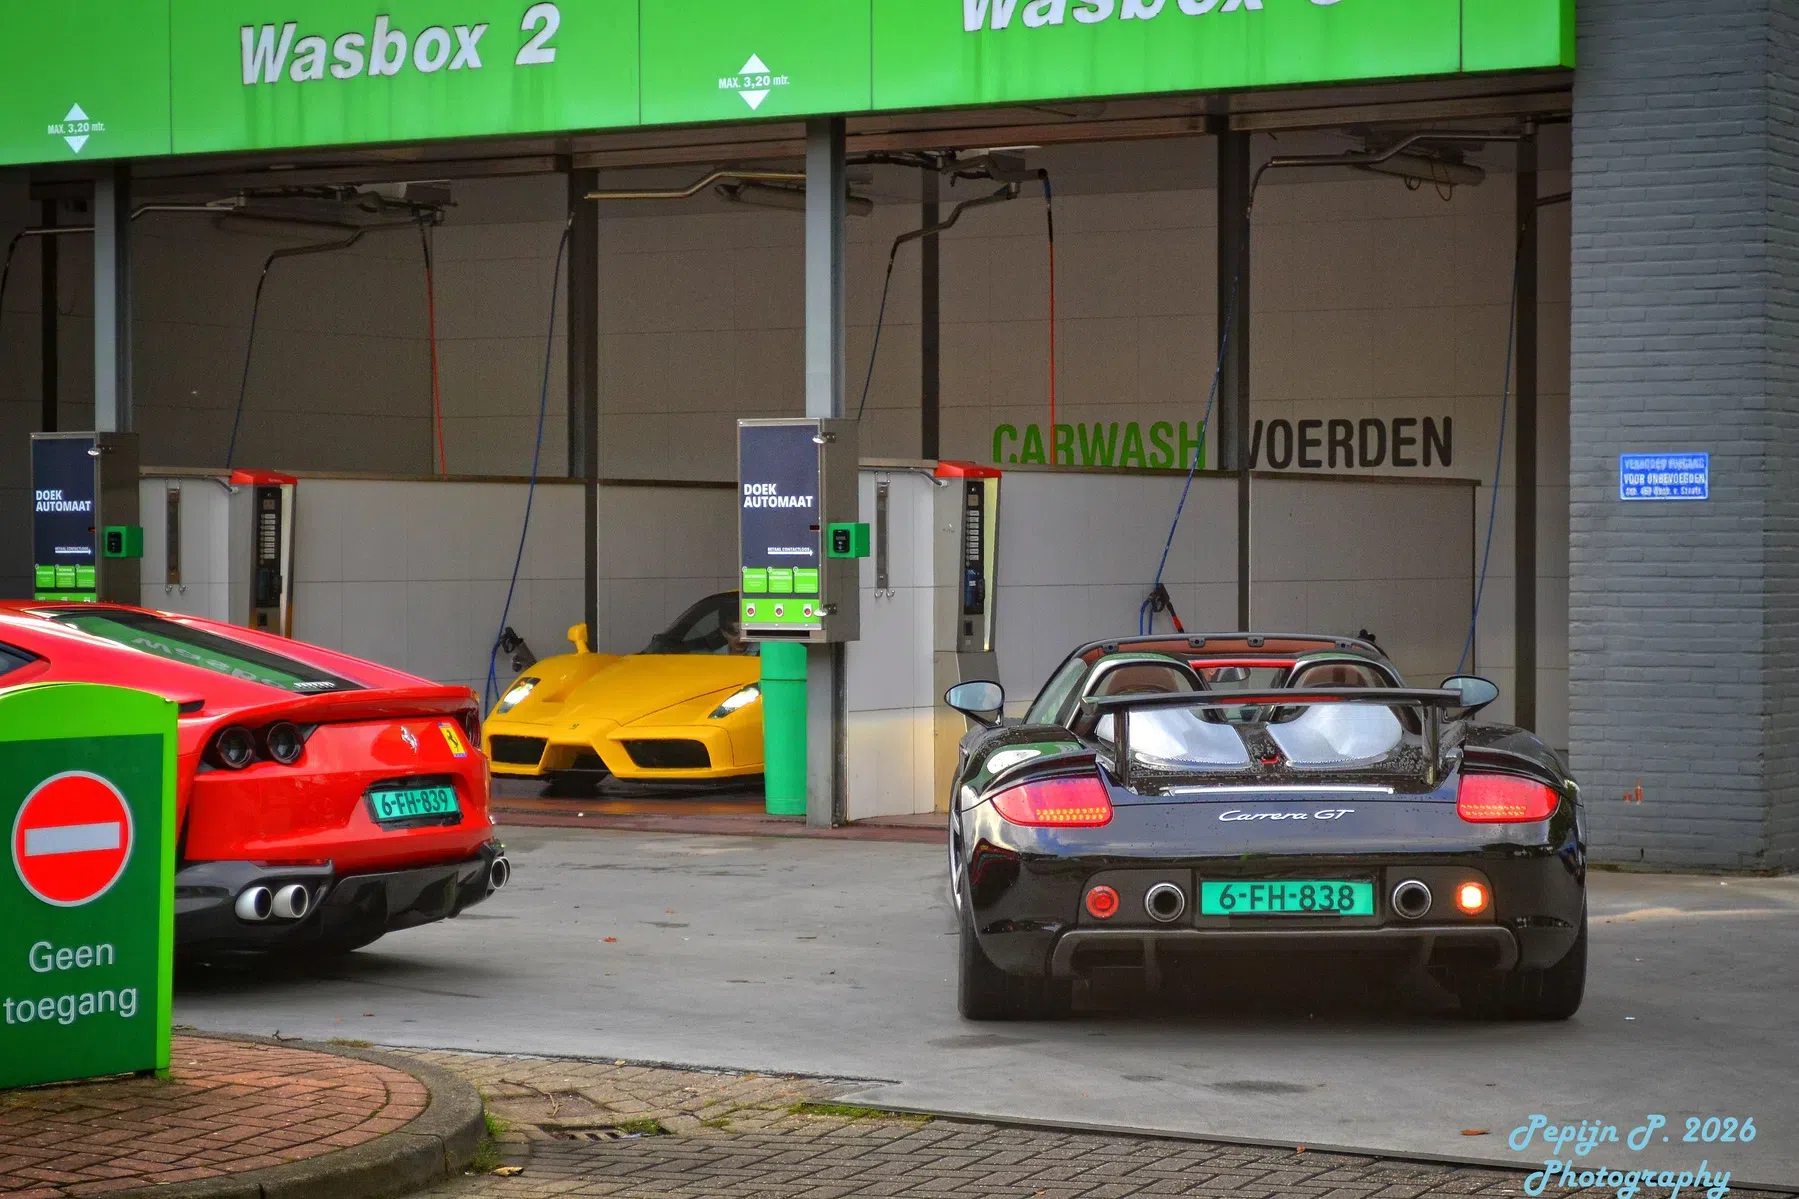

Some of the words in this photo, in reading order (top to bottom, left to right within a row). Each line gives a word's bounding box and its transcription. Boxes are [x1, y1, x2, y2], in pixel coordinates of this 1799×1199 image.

[240, 14, 490, 86] Wasbox
[514, 2, 561, 65] 2
[718, 77, 741, 89] MAX.
[744, 75, 770, 89] 3,20
[773, 74, 790, 86] mtr.
[47, 124, 66, 135] MAX.
[68, 122, 90, 134] 3,20
[91, 121, 106, 132] mtr.
[992, 420, 1206, 470] CARWASH
[1623, 473, 1645, 485] VOOR
[36, 490, 62, 500] DOEK
[744, 484, 776, 495] DOEK
[36, 500, 91, 512] AUTOMAAT
[743, 496, 813, 508] AUTOMAAT
[381, 789, 448, 816] 6-FH-839
[1218, 809, 1308, 821] Carrera
[1314, 809, 1355, 820] GT
[1219, 884, 1355, 911] 6-FH-838
[28, 941, 114, 973] Geen
[2, 987, 137, 1025] toegang
